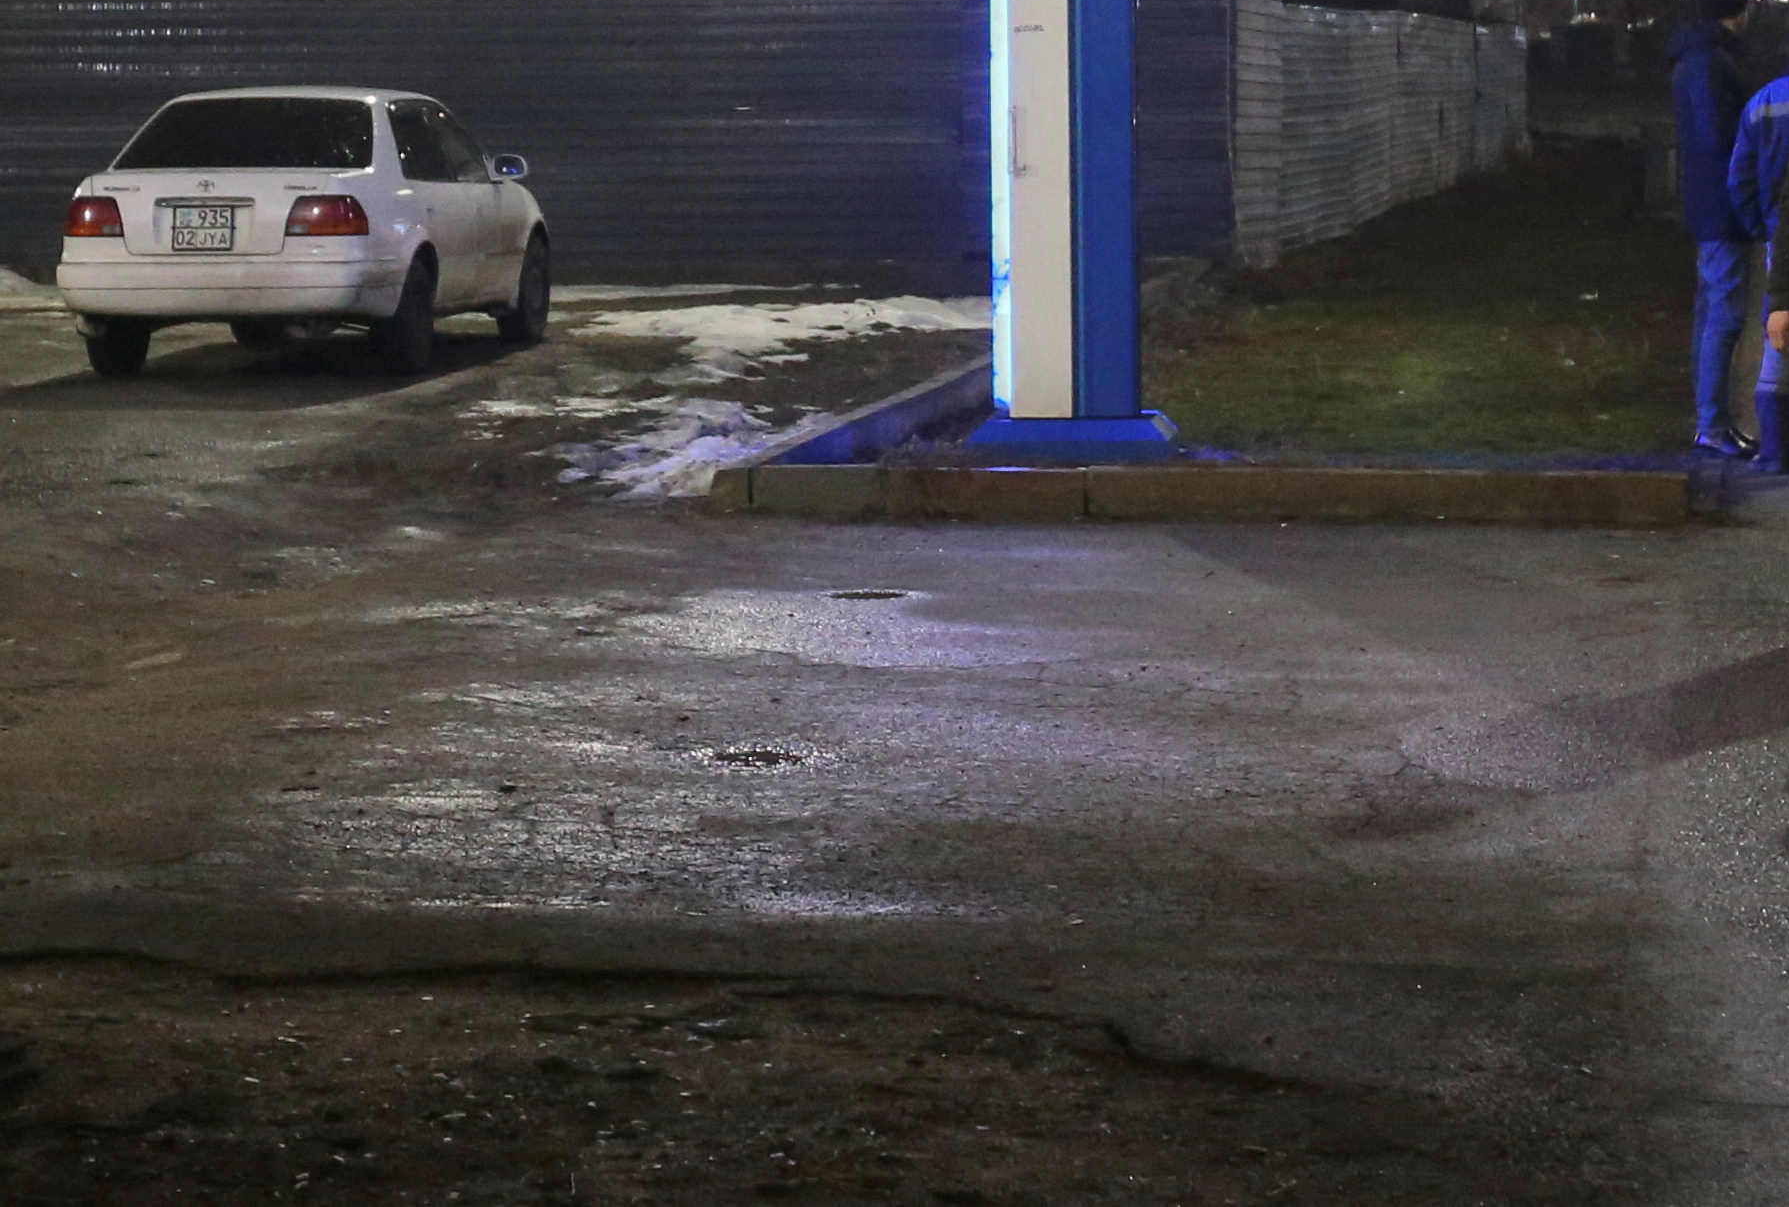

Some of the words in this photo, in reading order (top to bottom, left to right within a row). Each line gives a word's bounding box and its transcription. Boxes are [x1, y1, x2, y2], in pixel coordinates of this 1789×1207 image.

[198, 209, 230, 227] 935
[175, 230, 195, 246] 02
[199, 231, 228, 246] JYA
